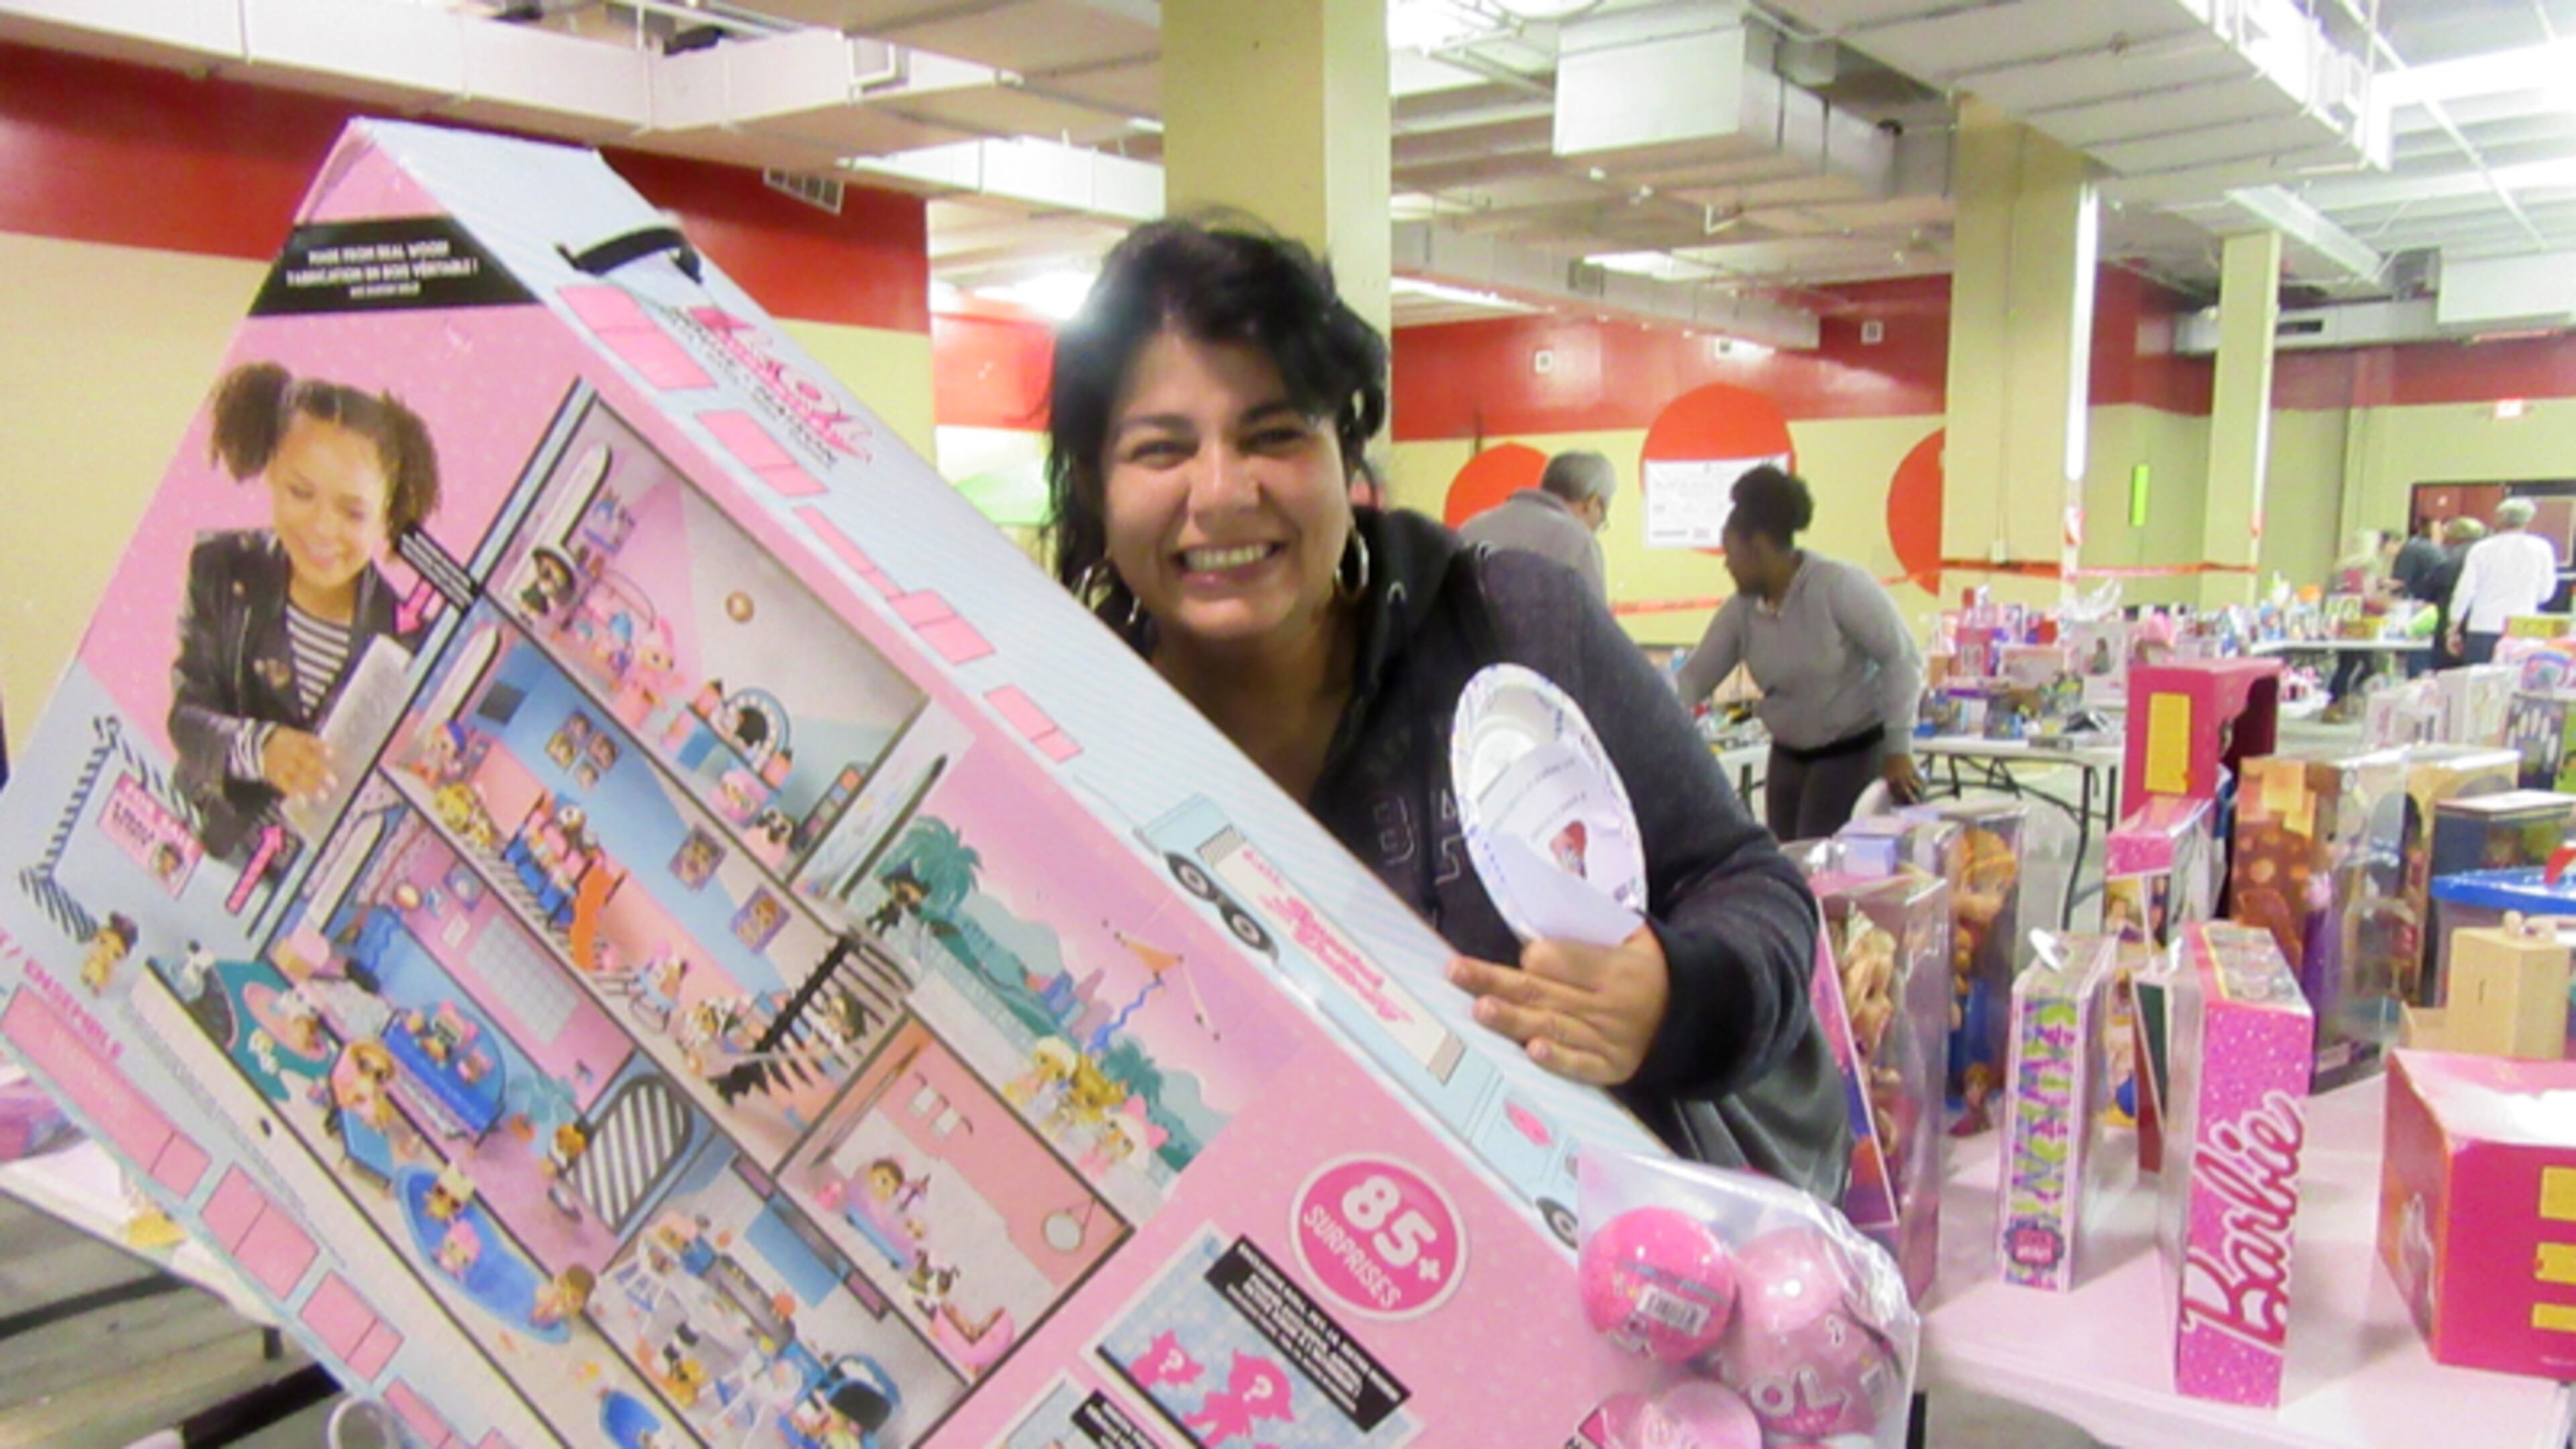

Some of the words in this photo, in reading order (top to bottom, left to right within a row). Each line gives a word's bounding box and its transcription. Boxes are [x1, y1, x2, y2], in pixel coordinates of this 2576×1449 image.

[1303, 1204, 1402, 1309] SURPRISES
[1342, 1174, 1441, 1282] 85+
[2180, 1088, 2306, 1356] Barbie
